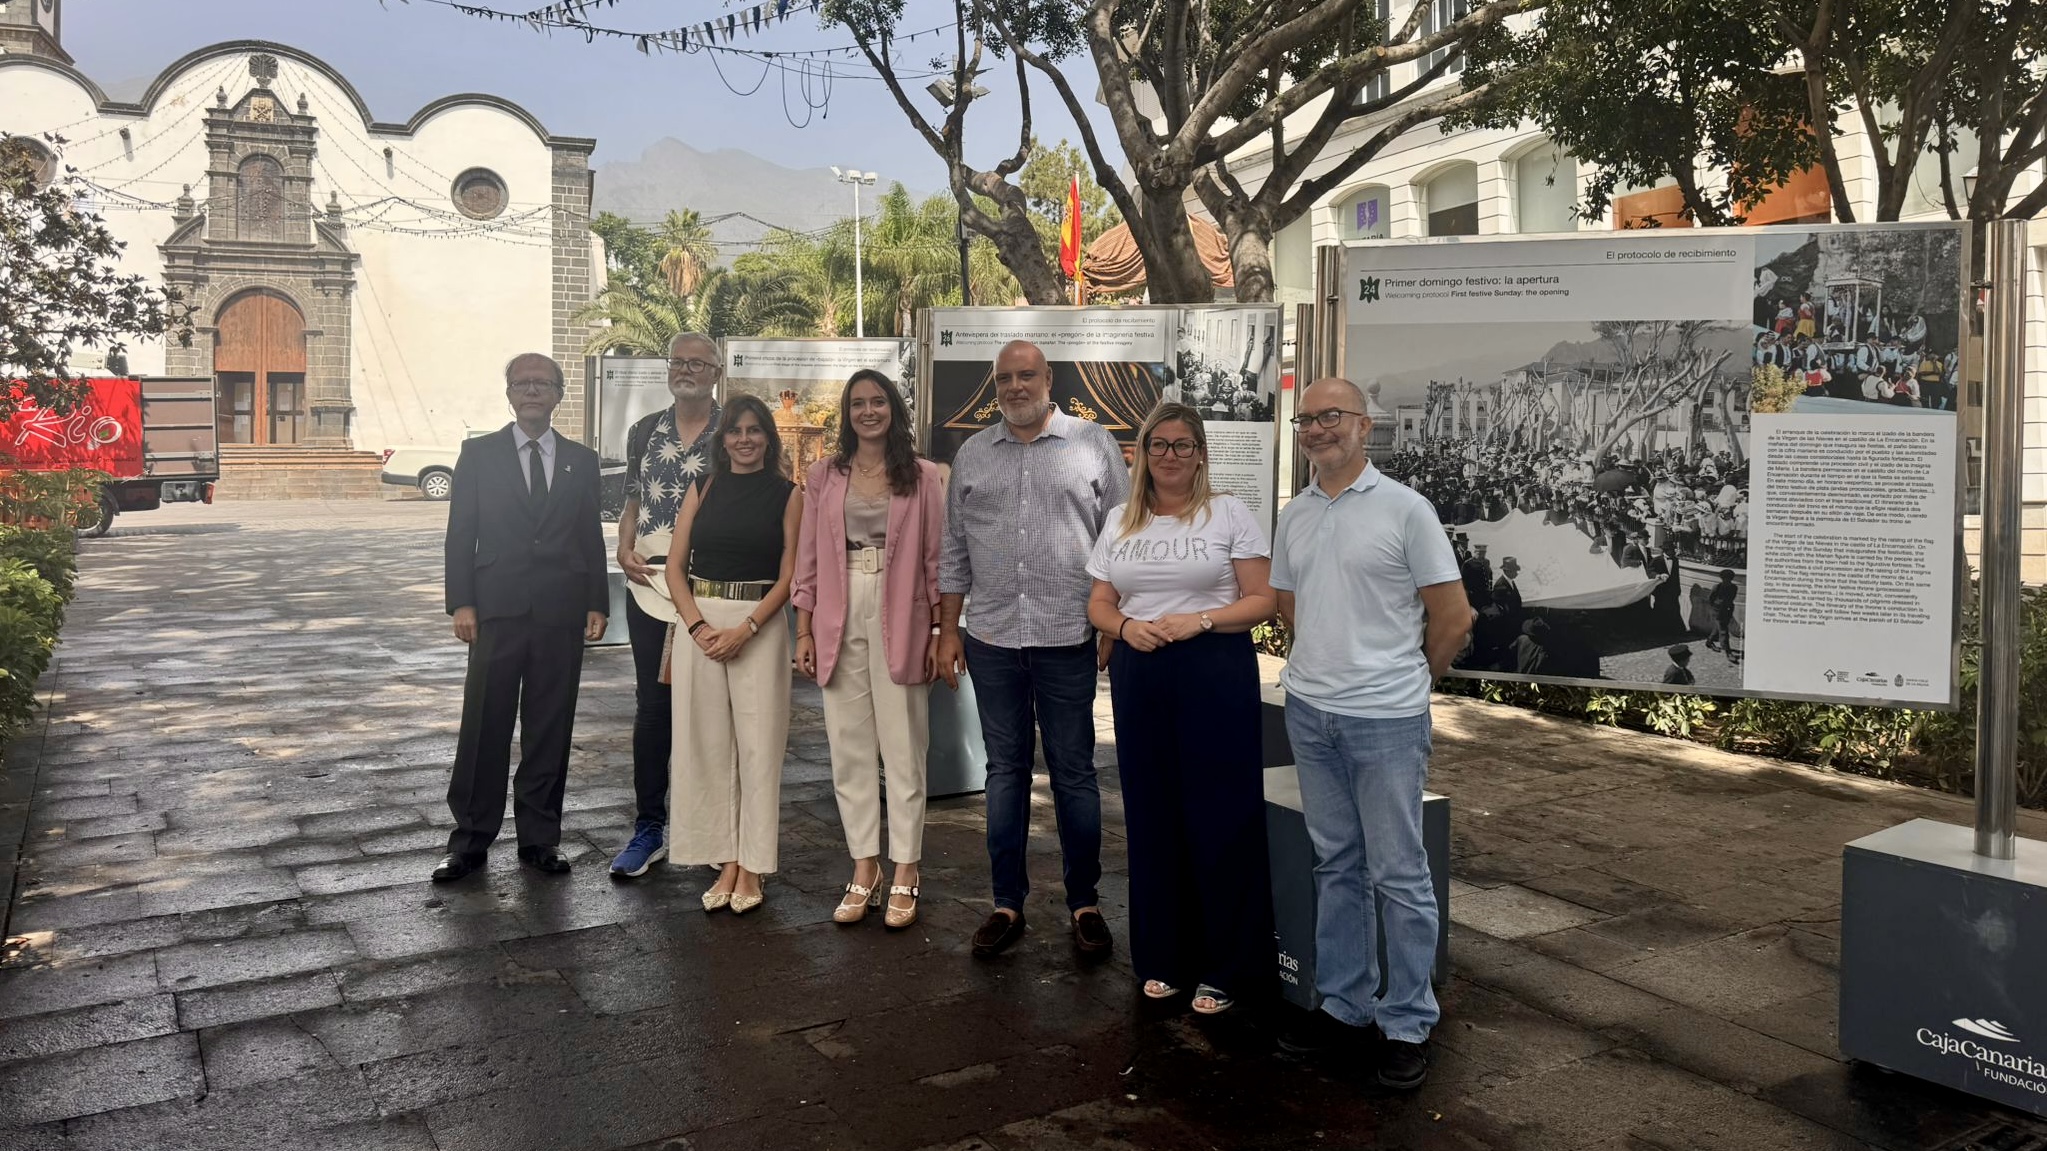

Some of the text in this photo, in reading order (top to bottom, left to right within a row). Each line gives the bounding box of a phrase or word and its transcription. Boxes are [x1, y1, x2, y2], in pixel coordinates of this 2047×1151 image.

[1606, 249, 1737, 261] El protocolo de recibimiento
[1364, 285, 1376, 294] 24
[1384, 276, 1560, 288] Primer domingo festivo: la apertura
[1540, 289, 1570, 297] opening
[1114, 538, 1209, 562] AMOUR
[1278, 950, 1298, 972] rias
[1916, 1028, 2047, 1079] CajaCanaria
[1984, 1068, 2047, 1094] FUNDACIÓ
